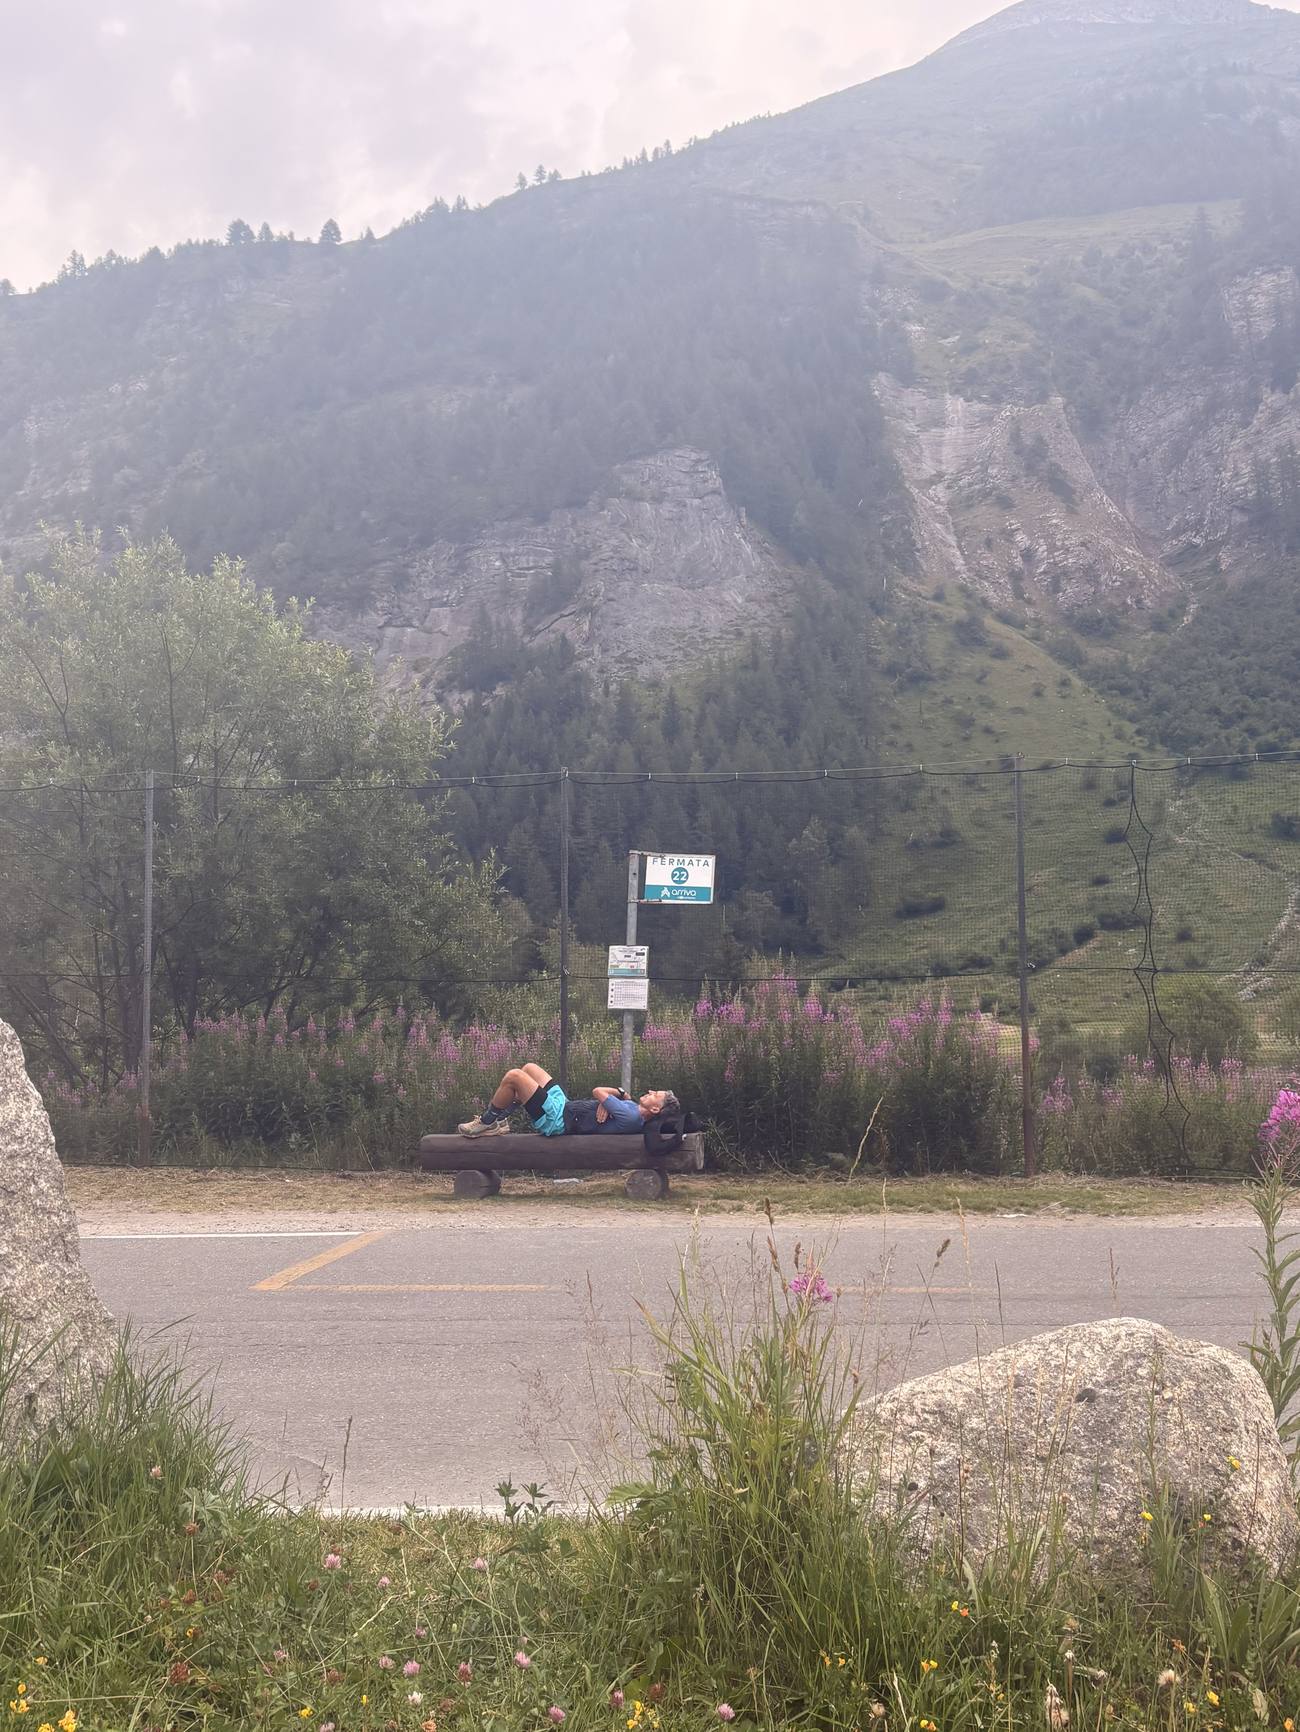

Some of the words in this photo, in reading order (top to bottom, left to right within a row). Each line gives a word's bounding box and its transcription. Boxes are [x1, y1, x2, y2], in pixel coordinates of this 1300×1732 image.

[652, 857, 710, 867] FERMATA
[672, 870, 688, 881] 22
[671, 889, 697, 897] arriva
